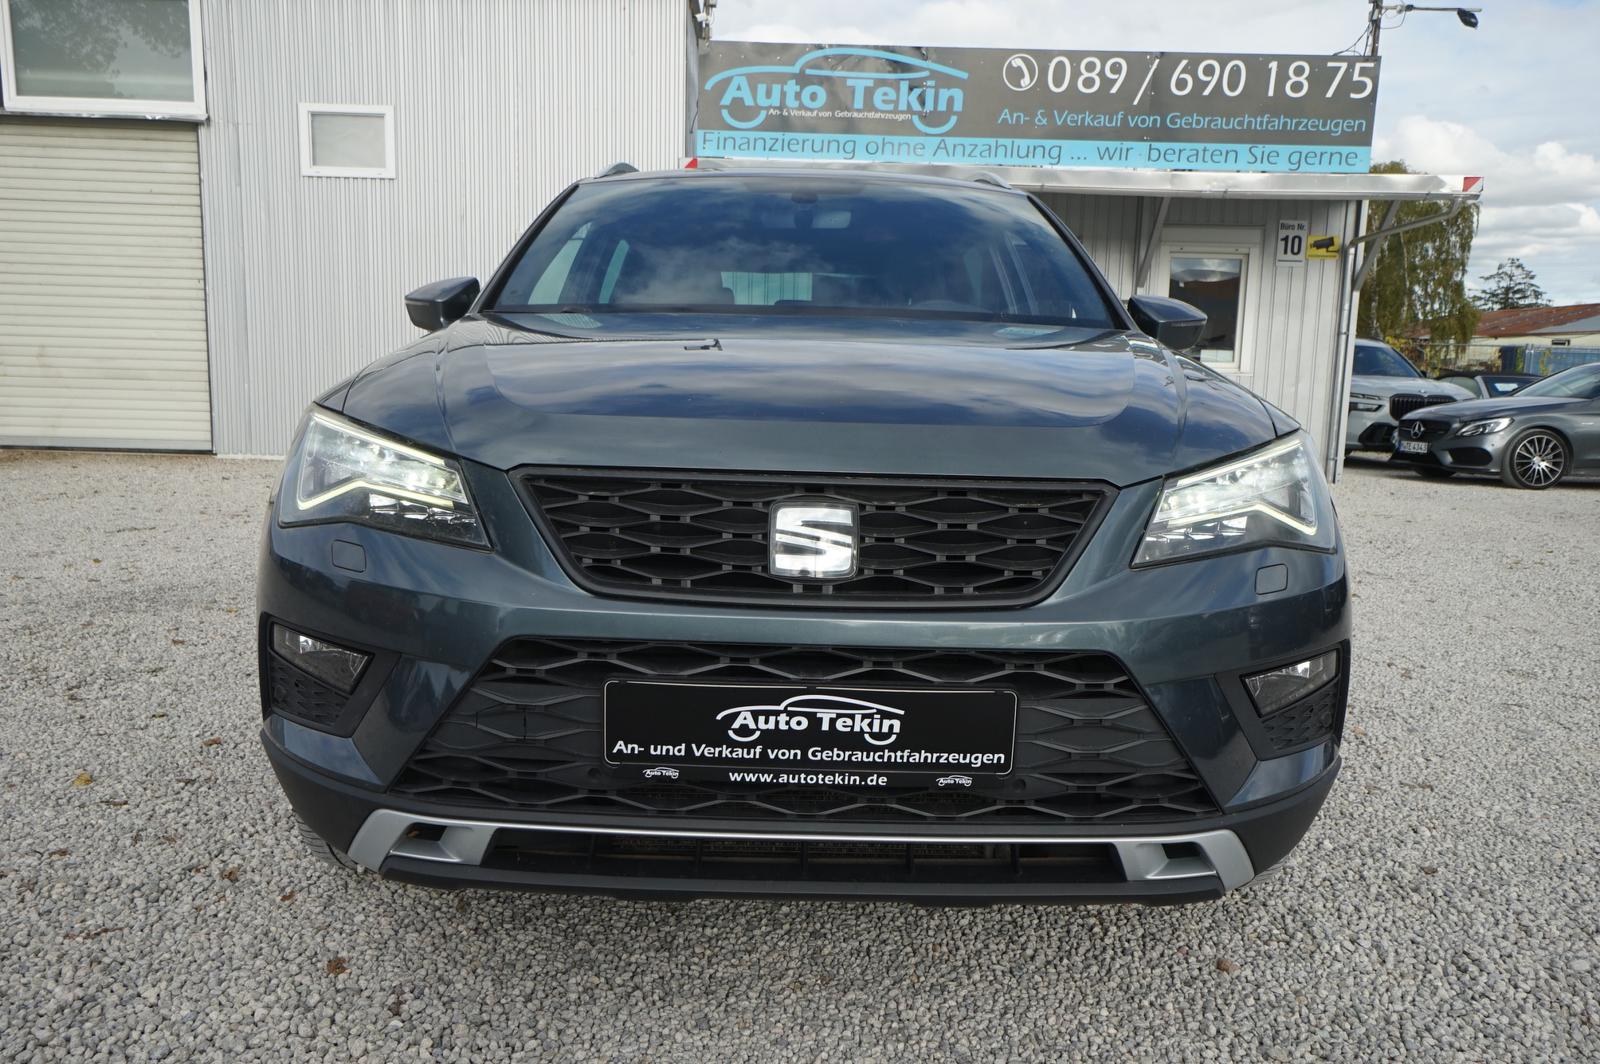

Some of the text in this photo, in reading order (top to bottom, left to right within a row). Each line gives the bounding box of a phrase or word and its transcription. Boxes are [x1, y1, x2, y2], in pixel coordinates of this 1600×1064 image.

[1047, 56, 1128, 94] 089
[1169, 59, 1247, 97] 690
[1267, 60, 1310, 98] 18
[1325, 61, 1375, 99] 75
[719, 76, 964, 112] Auto Tekin
[768, 108, 782, 116] An-
[790, 109, 817, 117] Verkauf
[834, 110, 912, 121] Gebrauchtfahrzeugen
[998, 108, 1366, 136] An- & Verkauf von Gebrauchtfahrzeugen
[701, 131, 857, 160] Finanzierung
[865, 133, 925, 157] ohne
[933, 138, 1062, 165] Anzahlung
[1097, 143, 1134, 162] wir
[1147, 143, 1238, 165] beraten
[1247, 145, 1280, 166] Sie
[1287, 149, 1359, 170] gerne
[1280, 222, 1295, 231] Büro
[1280, 235, 1302, 255] 10
[731, 711, 901, 734] Auto Tekin
[612, 740, 1006, 767] An- und Verkauf von Gebrauchtfahrzeugen
[645, 769, 679, 778] Auto Tekin
[728, 769, 888, 787] www.autotekin.de
